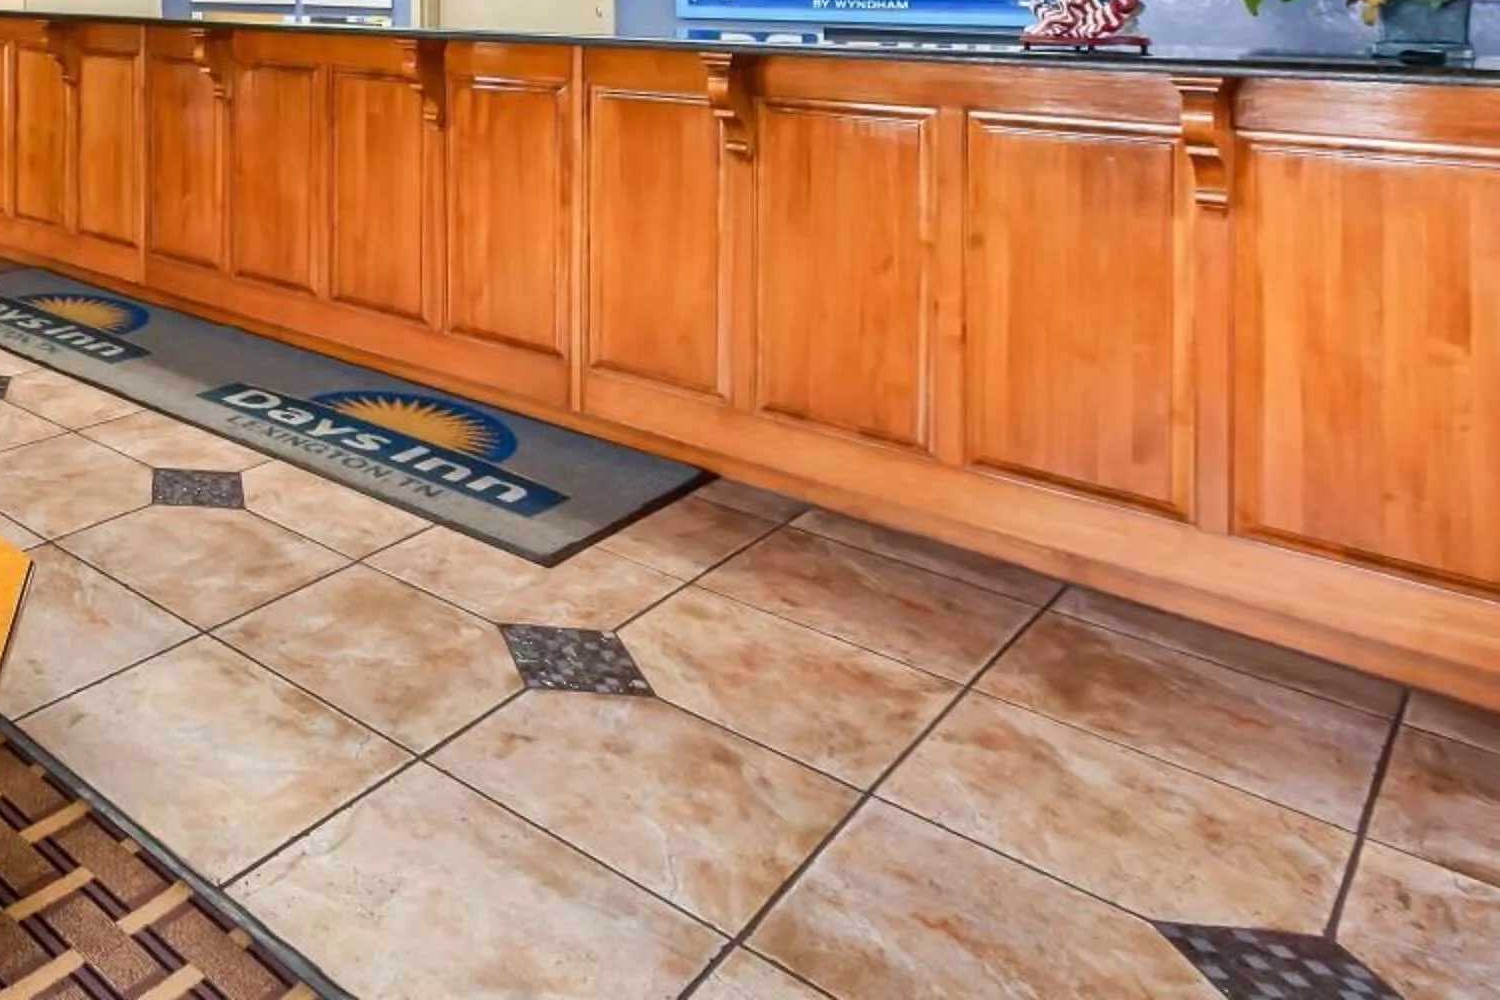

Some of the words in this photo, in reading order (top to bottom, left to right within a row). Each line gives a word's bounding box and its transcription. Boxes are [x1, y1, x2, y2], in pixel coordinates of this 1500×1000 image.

[812, 0, 830, 9] BY
[835, 0, 910, 10] WYNDHAM
[222, 388, 392, 452] Days
[390, 445, 530, 504] Inn
[398, 477, 444, 497] TN
